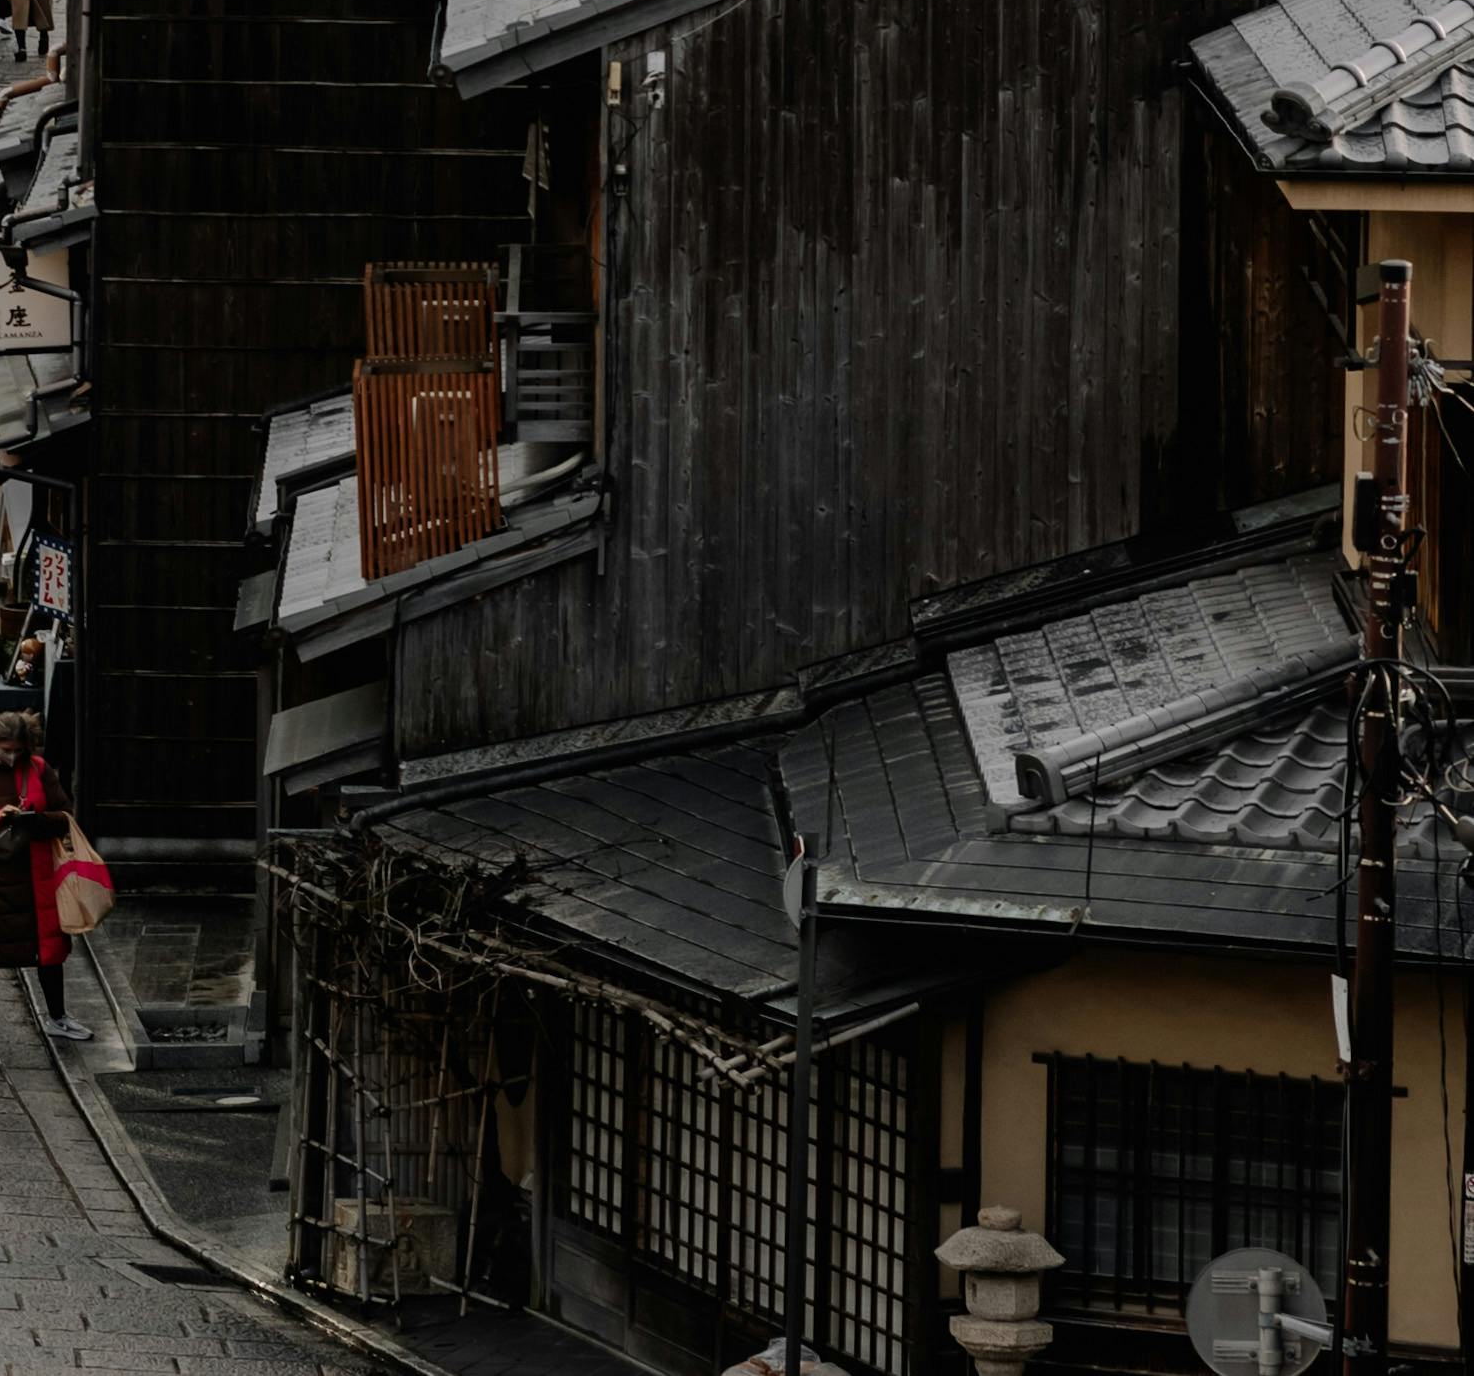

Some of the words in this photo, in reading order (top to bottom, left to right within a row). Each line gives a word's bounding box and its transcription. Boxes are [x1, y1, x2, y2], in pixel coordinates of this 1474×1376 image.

[42, 555, 55, 606] クリーム
[55, 552, 65, 590] ソフト
